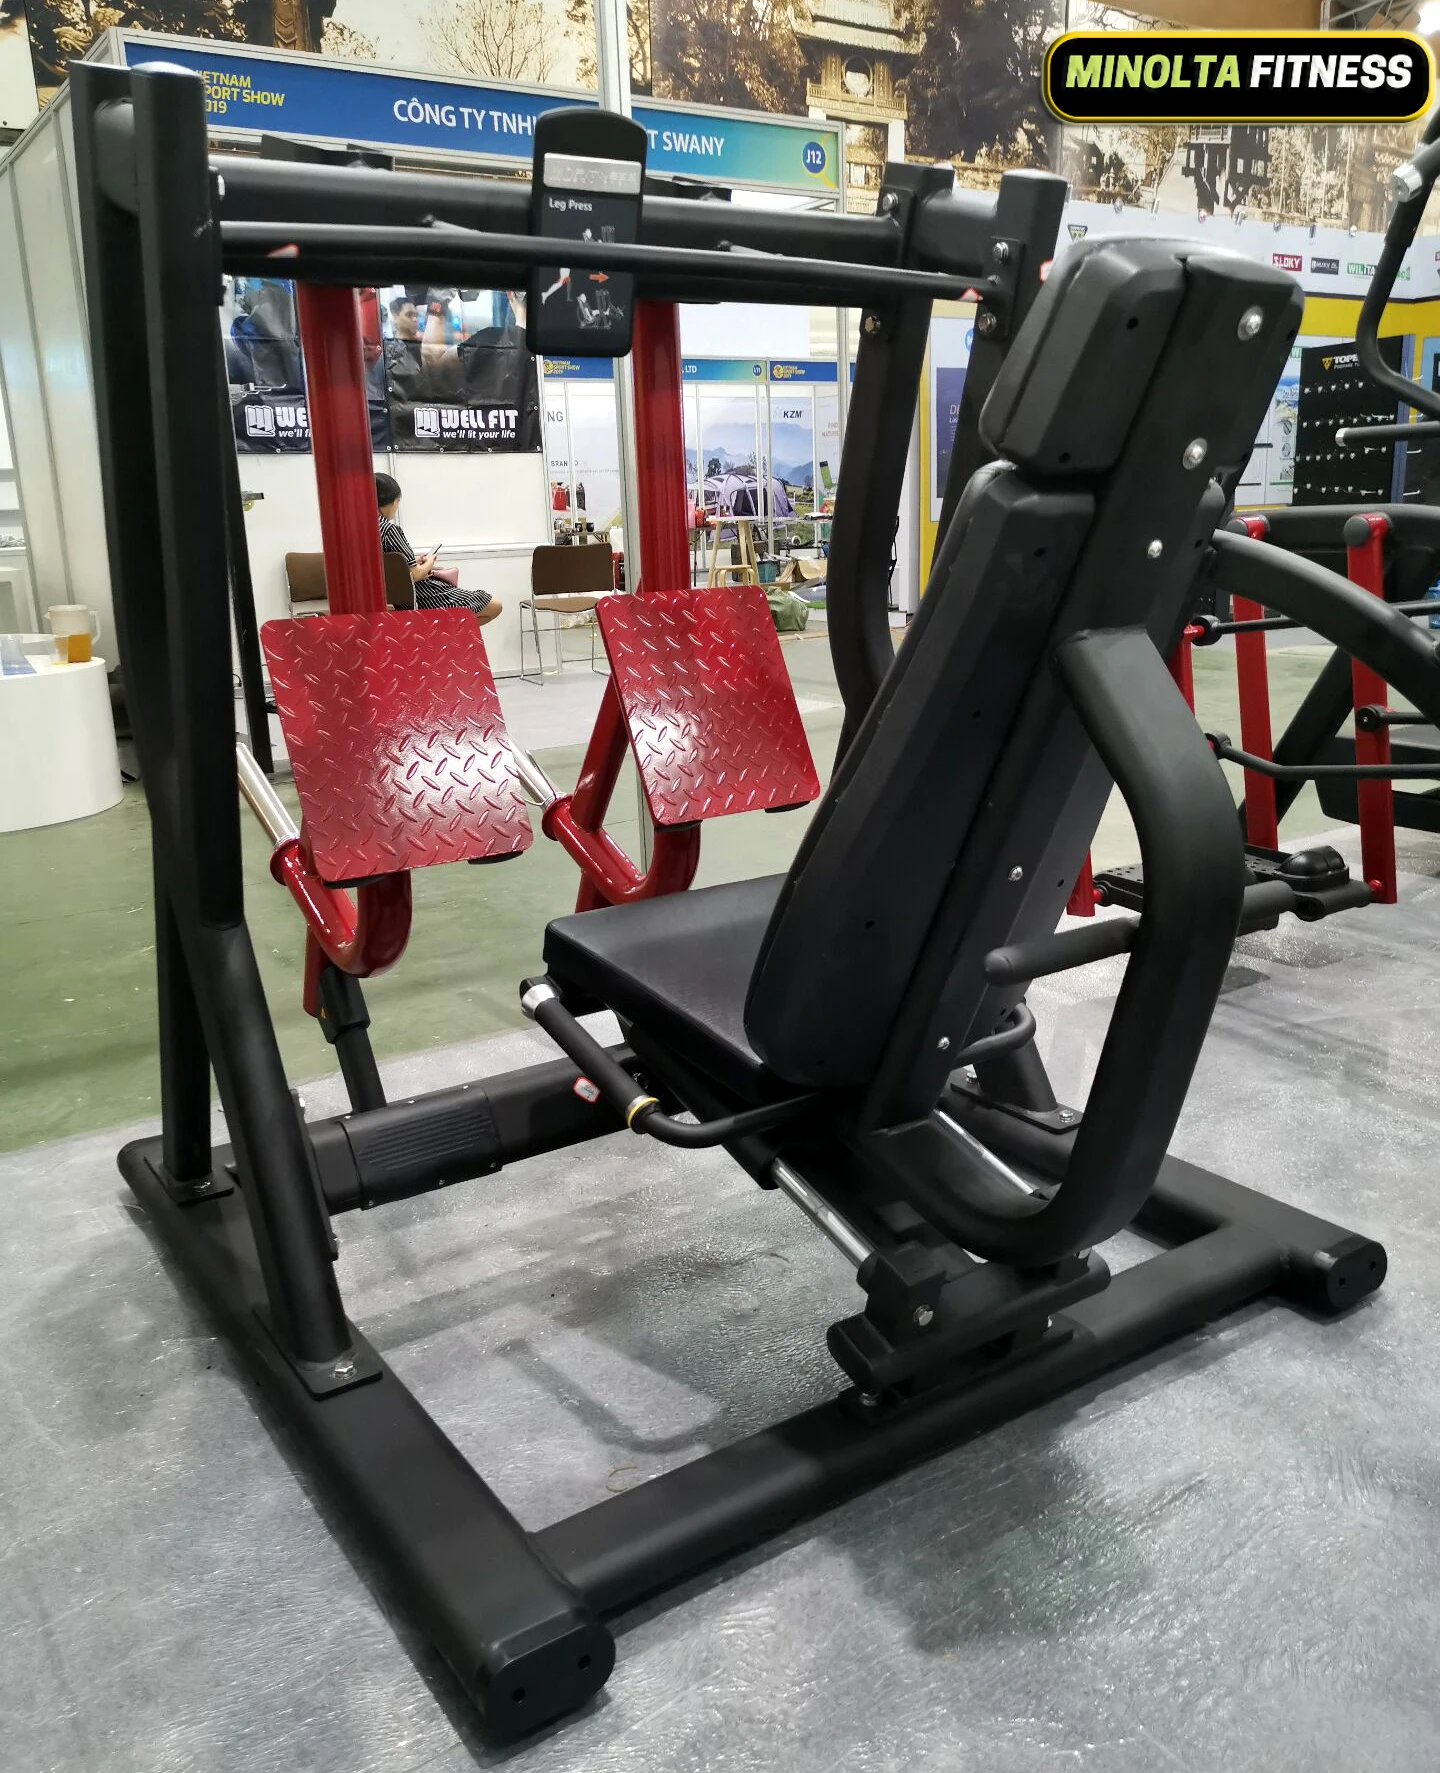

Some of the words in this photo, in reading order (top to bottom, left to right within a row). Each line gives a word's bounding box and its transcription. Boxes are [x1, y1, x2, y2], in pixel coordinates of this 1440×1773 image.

[196, 70, 251, 88] ETNAM
[205, 85, 240, 101] PORT
[242, 89, 285, 106] SHOW
[206, 99, 227, 114] 019
[393, 97, 456, 127] CÔNG
[459, 107, 486, 131] TY
[489, 110, 536, 136] TNH
[662, 131, 724, 157] SWANY
[806, 149, 822, 165] J12
[549, 197, 566, 211] Leg
[568, 200, 593, 211] Press
[1272, 255, 1301, 268] SLOKY
[1333, 354, 1358, 364] TOPE
[685, 365, 697, 373] LTD
[275, 406, 308, 427] WE
[441, 409, 486, 429] WELL
[488, 409, 519, 429] FIT
[783, 410, 803, 419] KZM
[278, 428, 303, 438] we'll
[442, 430, 466, 439] we'll
[467, 430, 477, 439] fit
[478, 431, 499, 440] your
[501, 430, 516, 439] life
